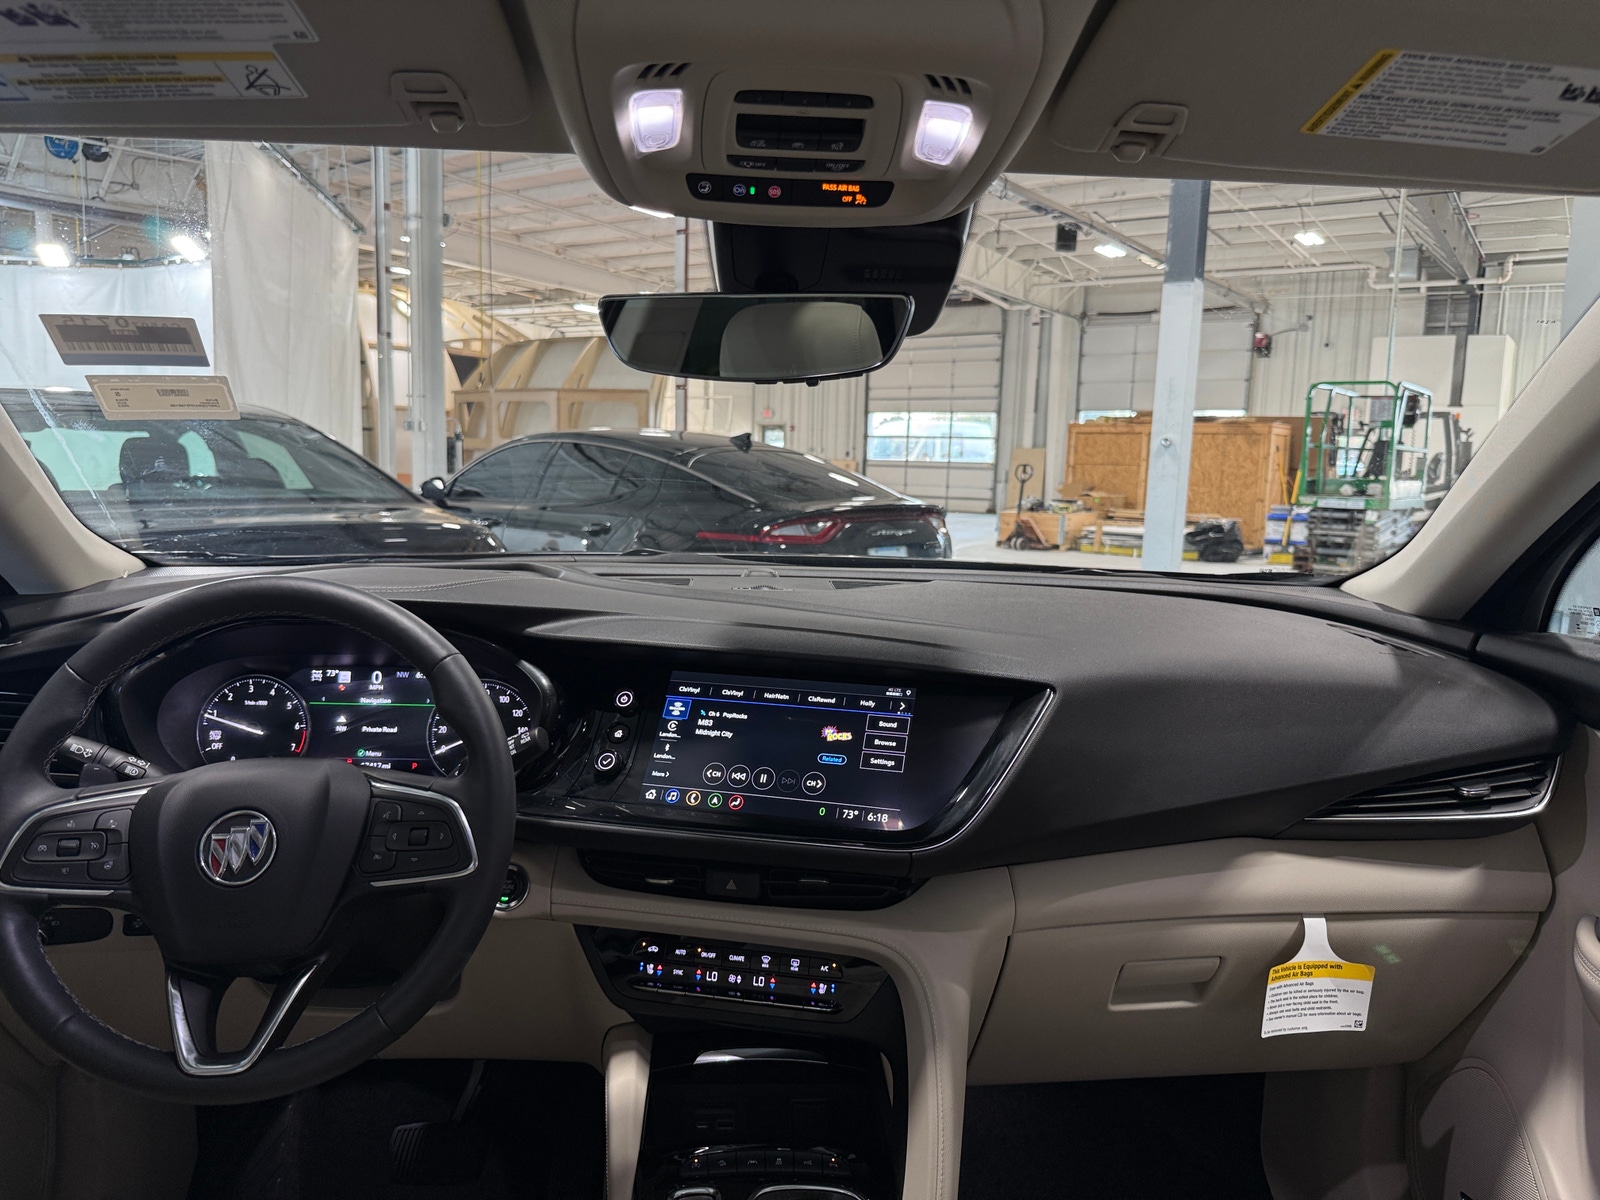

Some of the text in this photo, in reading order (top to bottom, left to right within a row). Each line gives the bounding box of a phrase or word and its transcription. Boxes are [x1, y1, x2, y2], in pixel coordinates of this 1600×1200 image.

[372, 671, 382, 683] 0
[695, 729, 720, 737] Midnight
[870, 758, 895, 766] Settings
[843, 810, 859, 818] 73°
[867, 813, 888, 822] 6:18
[706, 971, 718, 982] LO
[1272, 972, 1291, 982] Advanced
[753, 976, 765, 987] LO
